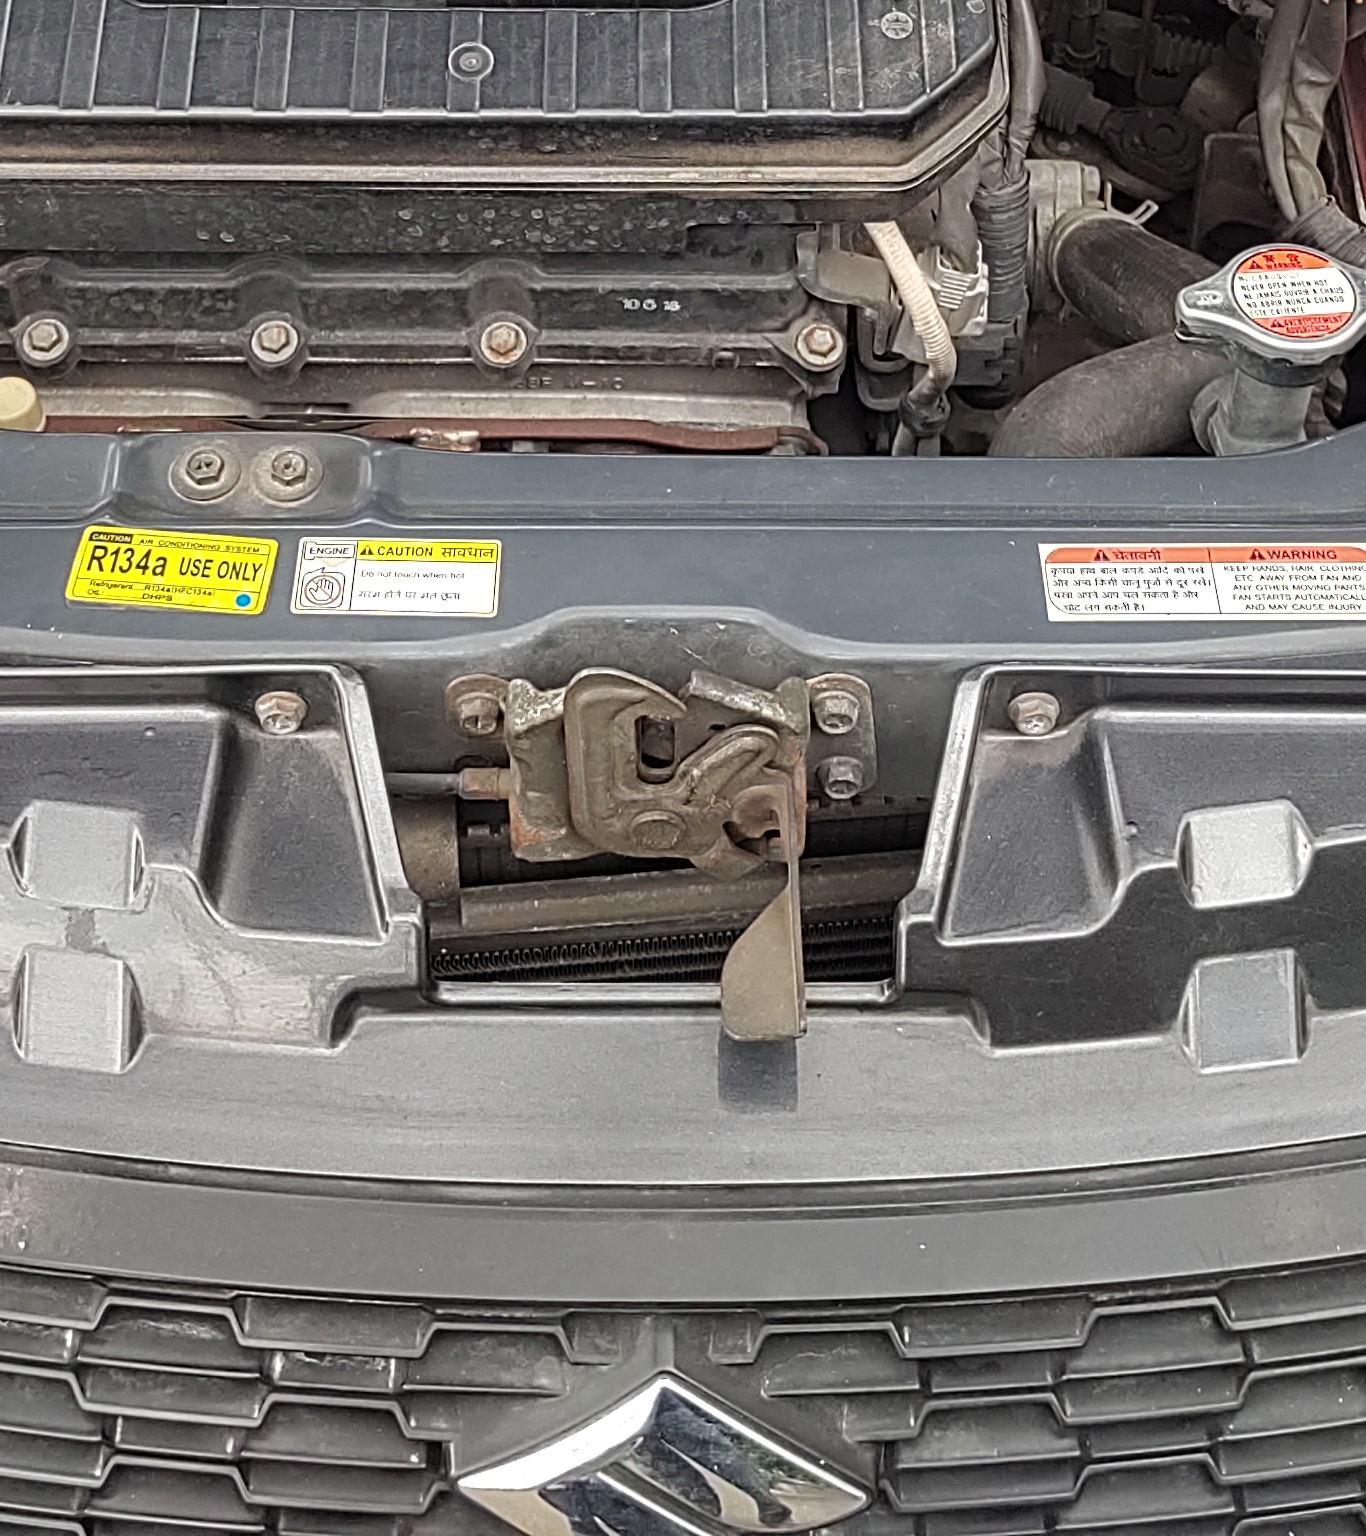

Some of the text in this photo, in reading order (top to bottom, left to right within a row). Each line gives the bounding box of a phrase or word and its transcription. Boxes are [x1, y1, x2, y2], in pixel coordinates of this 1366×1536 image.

[1241, 282, 1264, 291] NEVER
[1267, 281, 1287, 290] OPEN
[1290, 280, 1311, 288] WHEN
[1246, 301, 1257, 309] NO
[1285, 298, 1312, 306] NUNCA
[1314, 296, 1345, 304] CUANDO
[92, 533, 132, 542] CAUTION
[158, 539, 220, 551] CONDITIONING
[224, 544, 260, 553] SYSTEM
[309, 547, 350, 555] ENGINE
[377, 546, 495, 559] CAUTION सावधान
[1112, 547, 1161, 560] चेतावनी
[1266, 549, 1337, 560] WARNING
[87, 544, 264, 582] R134a USE ONLY
[361, 570, 374, 578] Do
